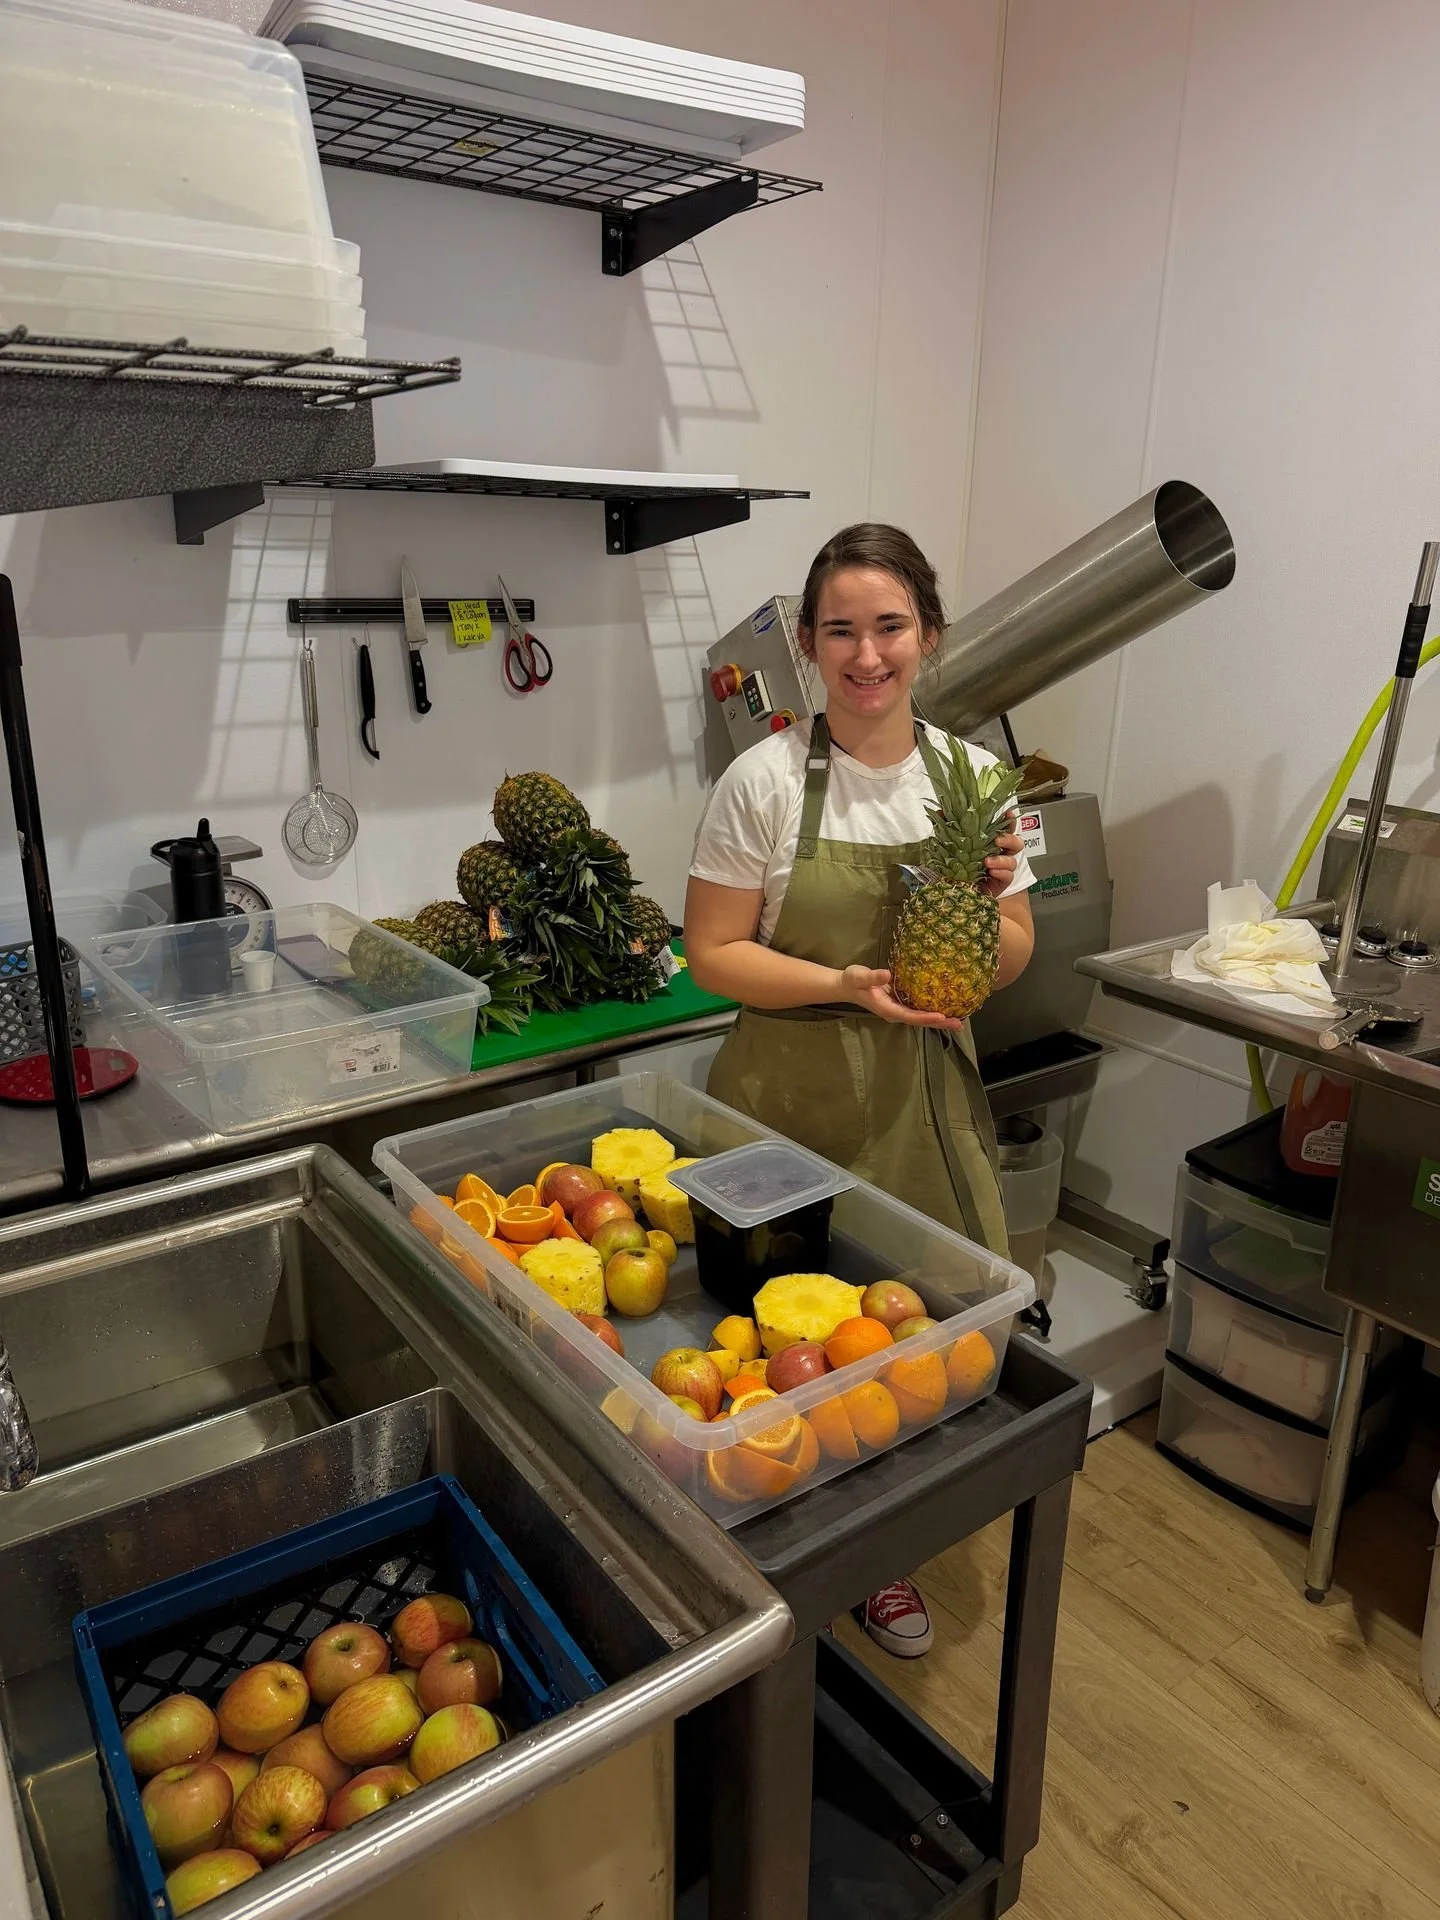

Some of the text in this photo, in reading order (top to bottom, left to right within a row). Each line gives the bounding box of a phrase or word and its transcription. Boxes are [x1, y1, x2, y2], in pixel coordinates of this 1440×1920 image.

[1024, 837, 1040, 849] POINT
[1041, 887, 1070, 899] Products,
[1428, 1173, 1440, 1192] S
